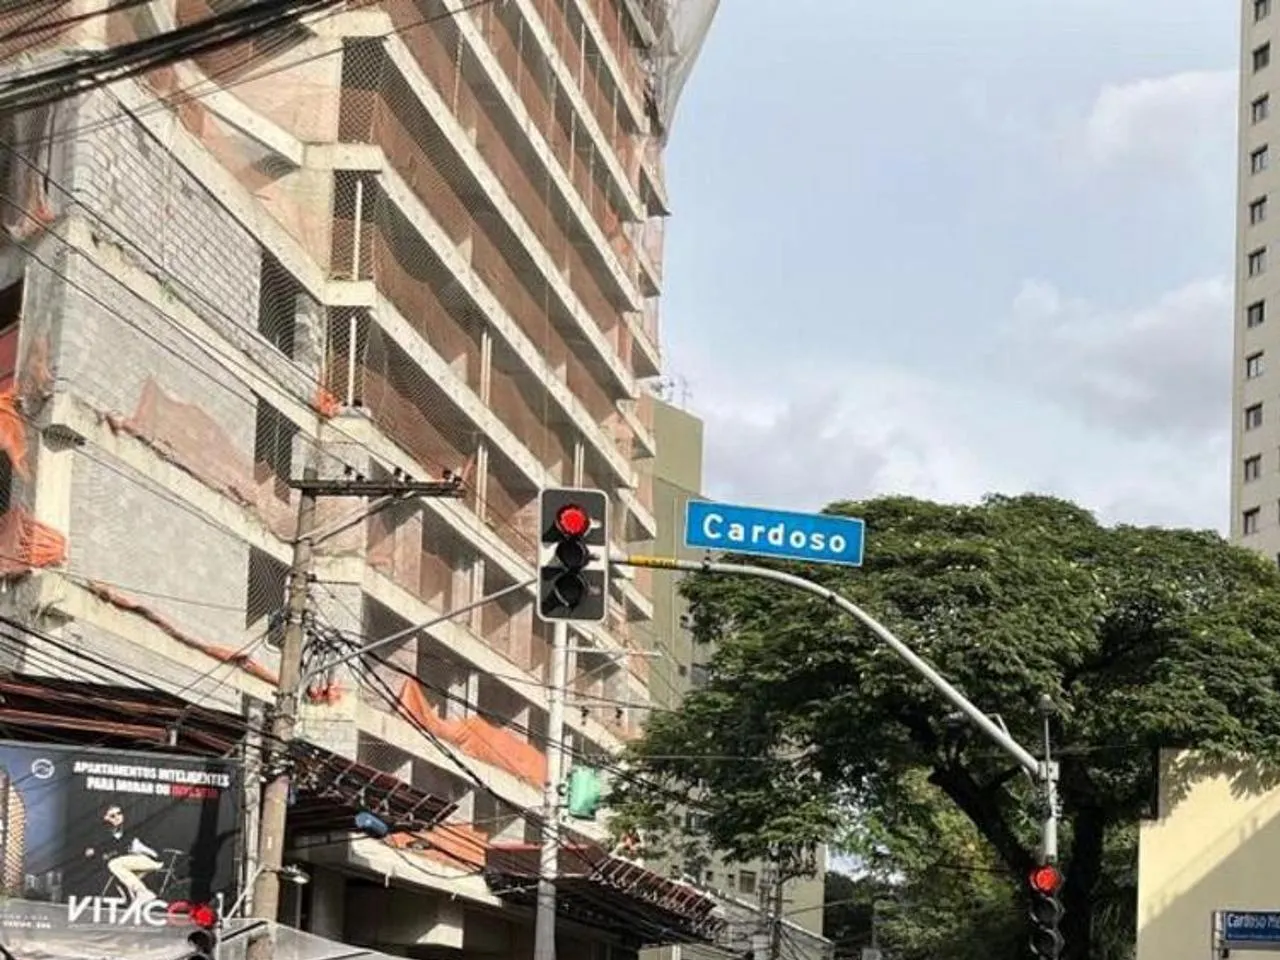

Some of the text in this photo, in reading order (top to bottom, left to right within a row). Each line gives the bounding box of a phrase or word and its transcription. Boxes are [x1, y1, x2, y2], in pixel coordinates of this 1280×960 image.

[703, 513, 846, 553] Cardoso
[73, 761, 230, 787] APARTAMENTOS INTELIGENTES
[86, 776, 115, 791] PARA
[115, 778, 154, 794] MORAR
